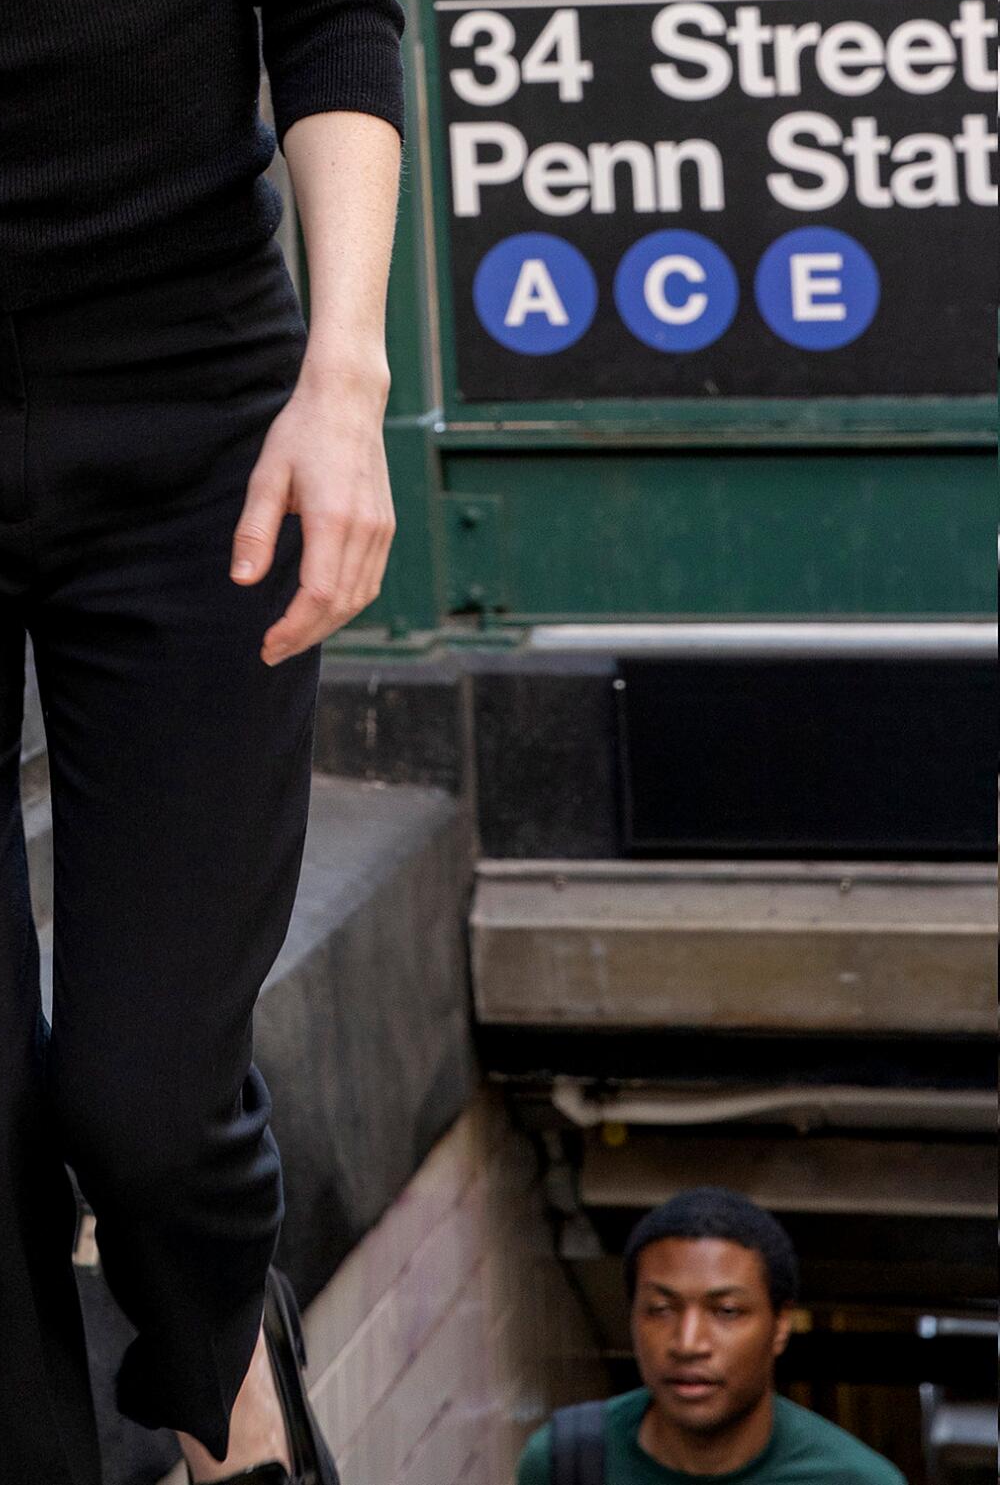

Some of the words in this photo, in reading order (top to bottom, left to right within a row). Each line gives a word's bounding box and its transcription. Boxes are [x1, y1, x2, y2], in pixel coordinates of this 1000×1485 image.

[449, 8, 593, 106] 34
[650, 0, 998, 102] Street
[449, 121, 726, 217] Penn
[766, 110, 998, 212] Stat
[504, 259, 570, 327] A
[643, 254, 708, 325] C
[789, 252, 847, 322] E
